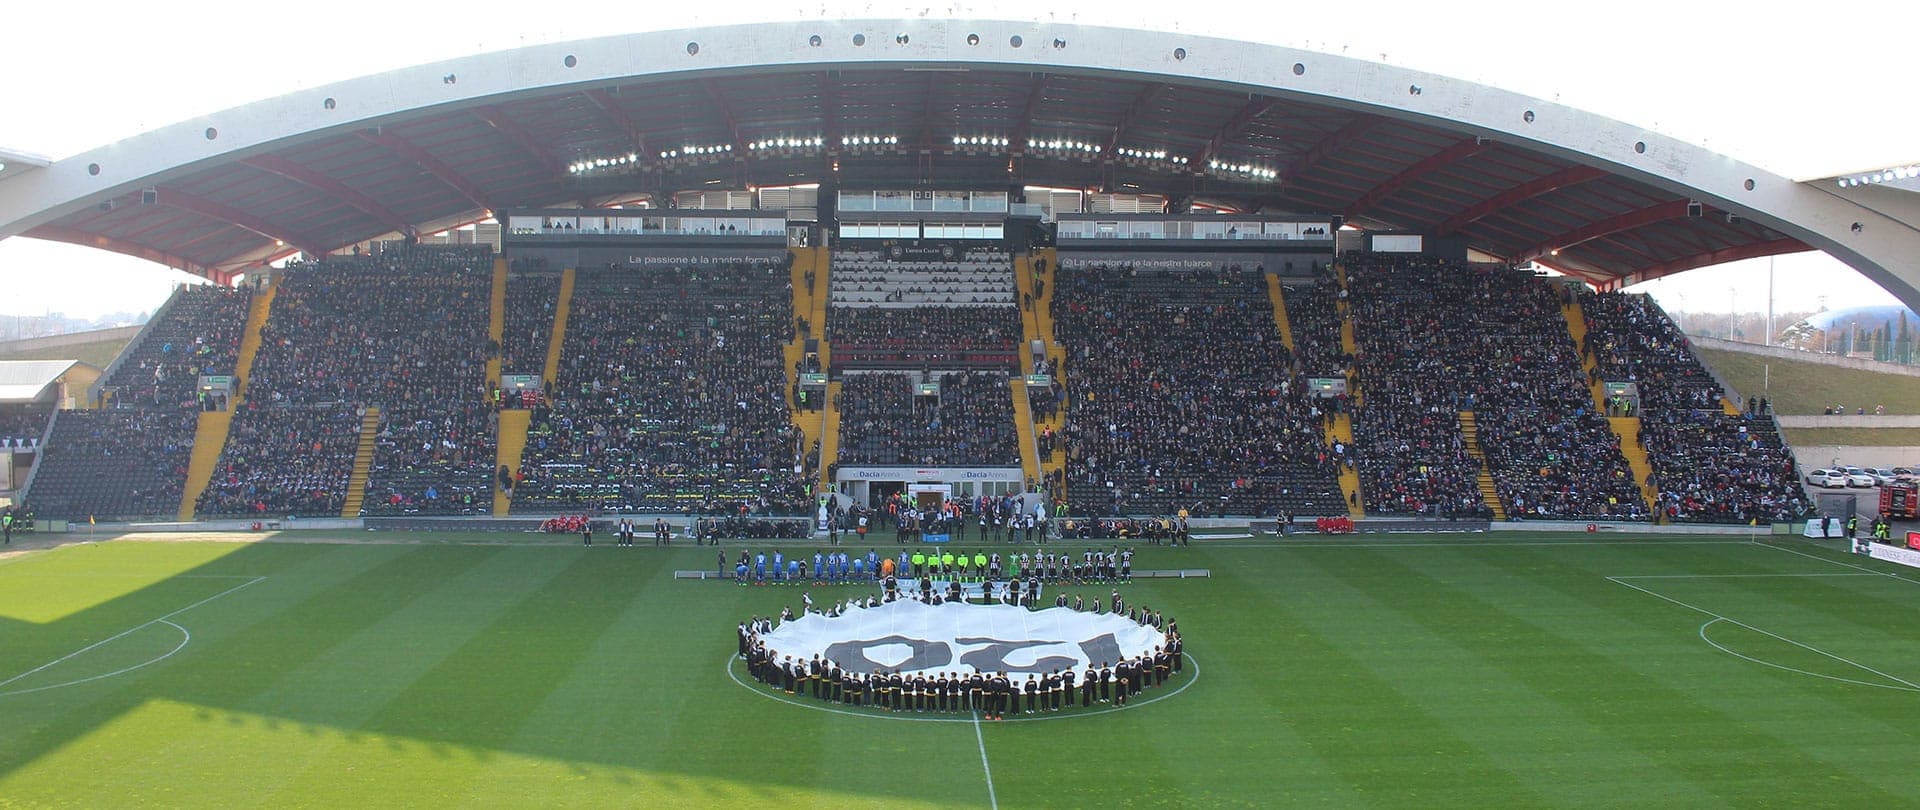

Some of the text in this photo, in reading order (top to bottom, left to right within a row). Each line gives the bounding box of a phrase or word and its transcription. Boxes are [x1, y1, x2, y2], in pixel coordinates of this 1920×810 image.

[629, 255, 642, 264] La
[644, 255, 688, 265] passione
[700, 255, 709, 264] la
[1074, 258, 1085, 266] La
